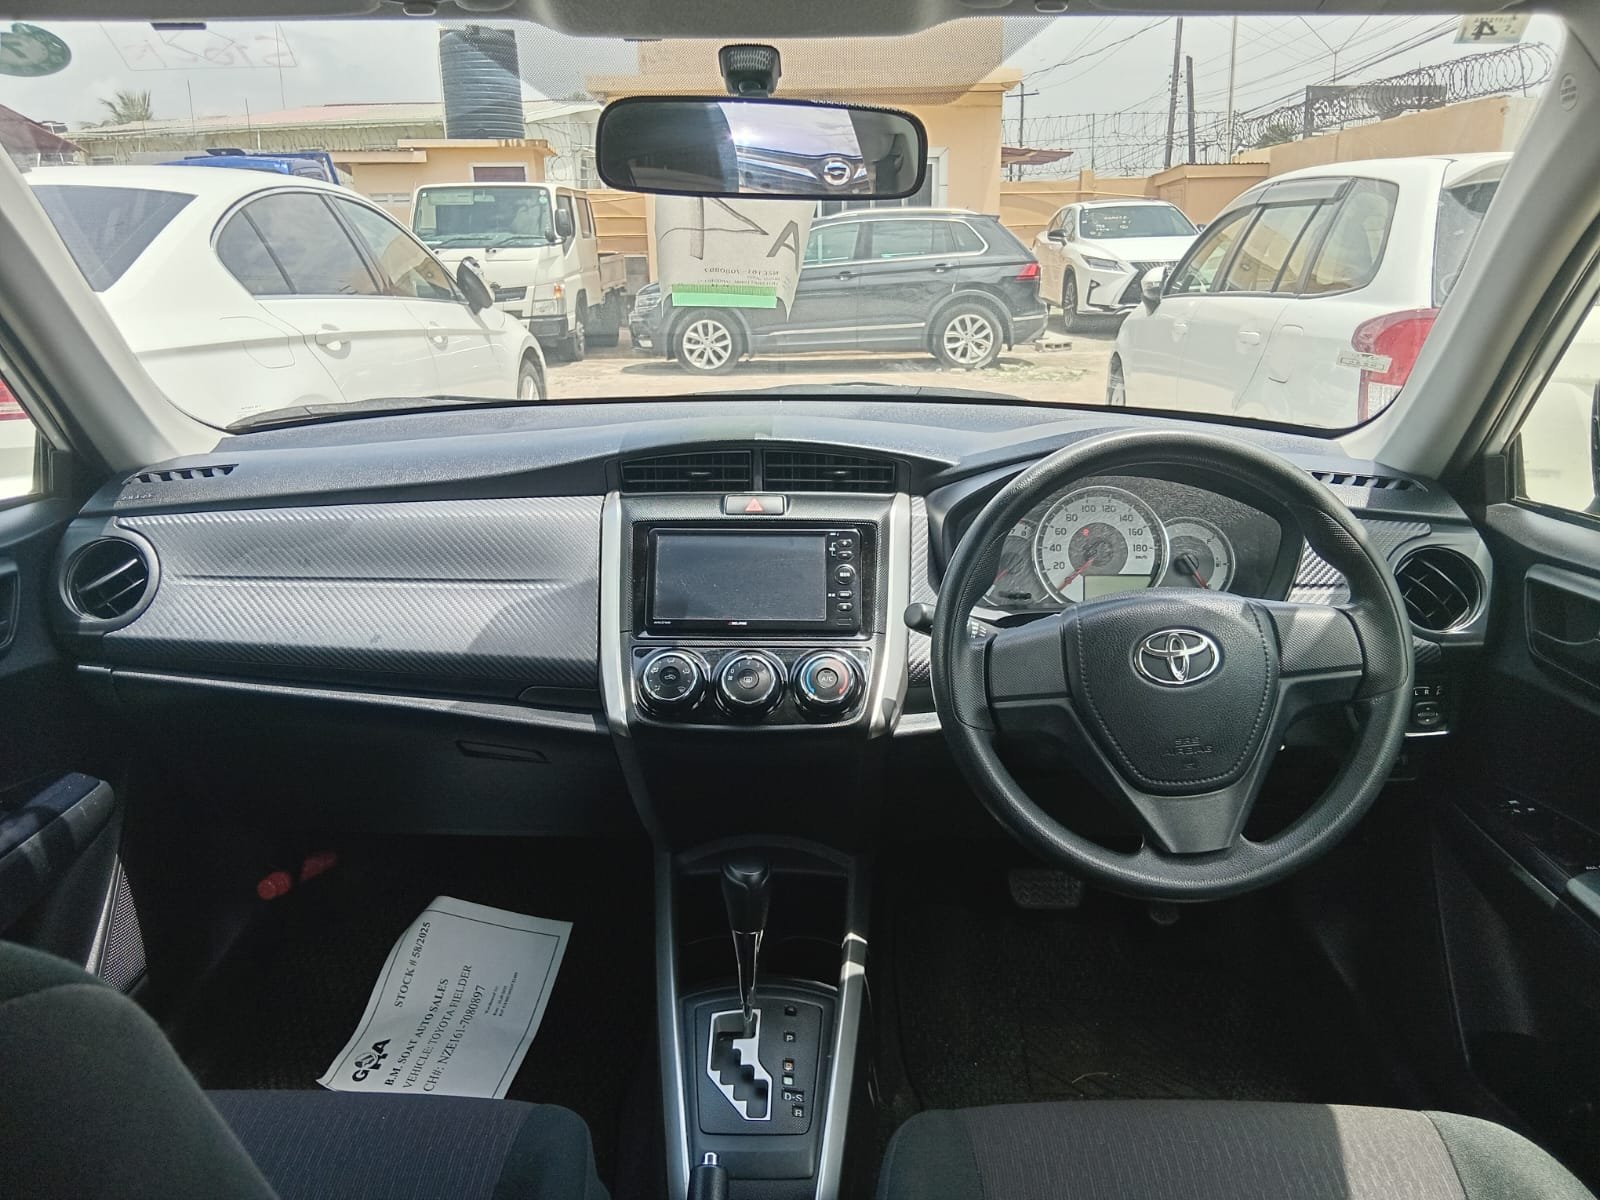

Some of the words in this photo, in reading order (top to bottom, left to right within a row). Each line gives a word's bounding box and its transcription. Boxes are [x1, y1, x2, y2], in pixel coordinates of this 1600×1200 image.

[1081, 505, 1096, 513] 100
[1102, 505, 1117, 513] 120
[1065, 514, 1078, 522] 80
[1119, 514, 1134, 522] 140
[1055, 527, 1067, 536] 60
[1128, 528, 1143, 536] 160
[1049, 544, 1062, 552] 40
[1133, 544, 1148, 552] 180
[1053, 561, 1065, 569] 20
[394, 967, 415, 1008] STOCK
[412, 922, 431, 959] 58/2025
[403, 1046, 431, 1089] VEHICLE:
[428, 1009, 455, 1046] TOYOTA
[449, 965, 472, 1009] FIELDER
[384, 1066, 402, 1086] B.M.
[398, 1039, 418, 1065] SOAT
[415, 1013, 434, 1038] AUTO
[429, 978, 449, 1013] SALES
[424, 1064, 445, 1092] CH#:
[438, 985, 486, 1065] NZE161-7080897
[786, 1034, 793, 1042] P
